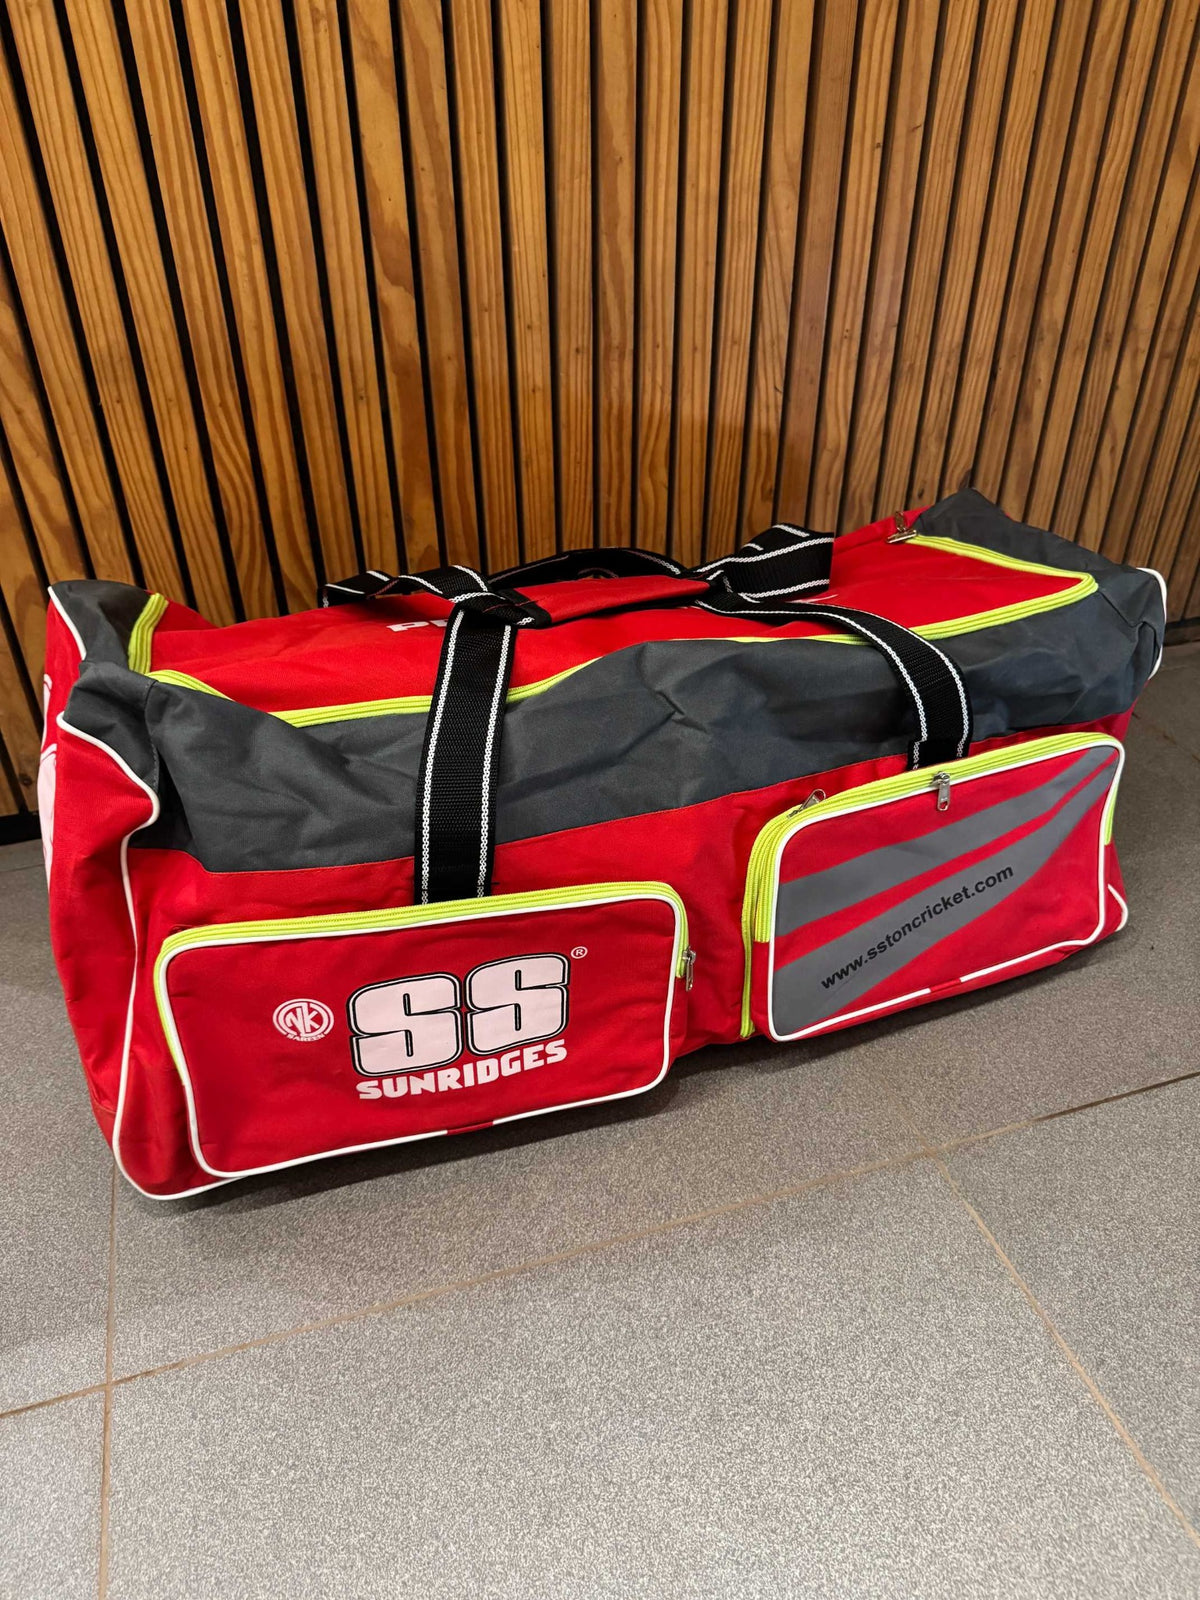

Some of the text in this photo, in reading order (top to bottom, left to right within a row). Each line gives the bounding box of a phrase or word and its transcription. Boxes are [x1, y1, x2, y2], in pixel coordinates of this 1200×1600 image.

[820, 865, 1014, 990] www.sstoncricket.com
[346, 952, 571, 1078] SS
[355, 1038, 568, 1100] SUNRIDGES
